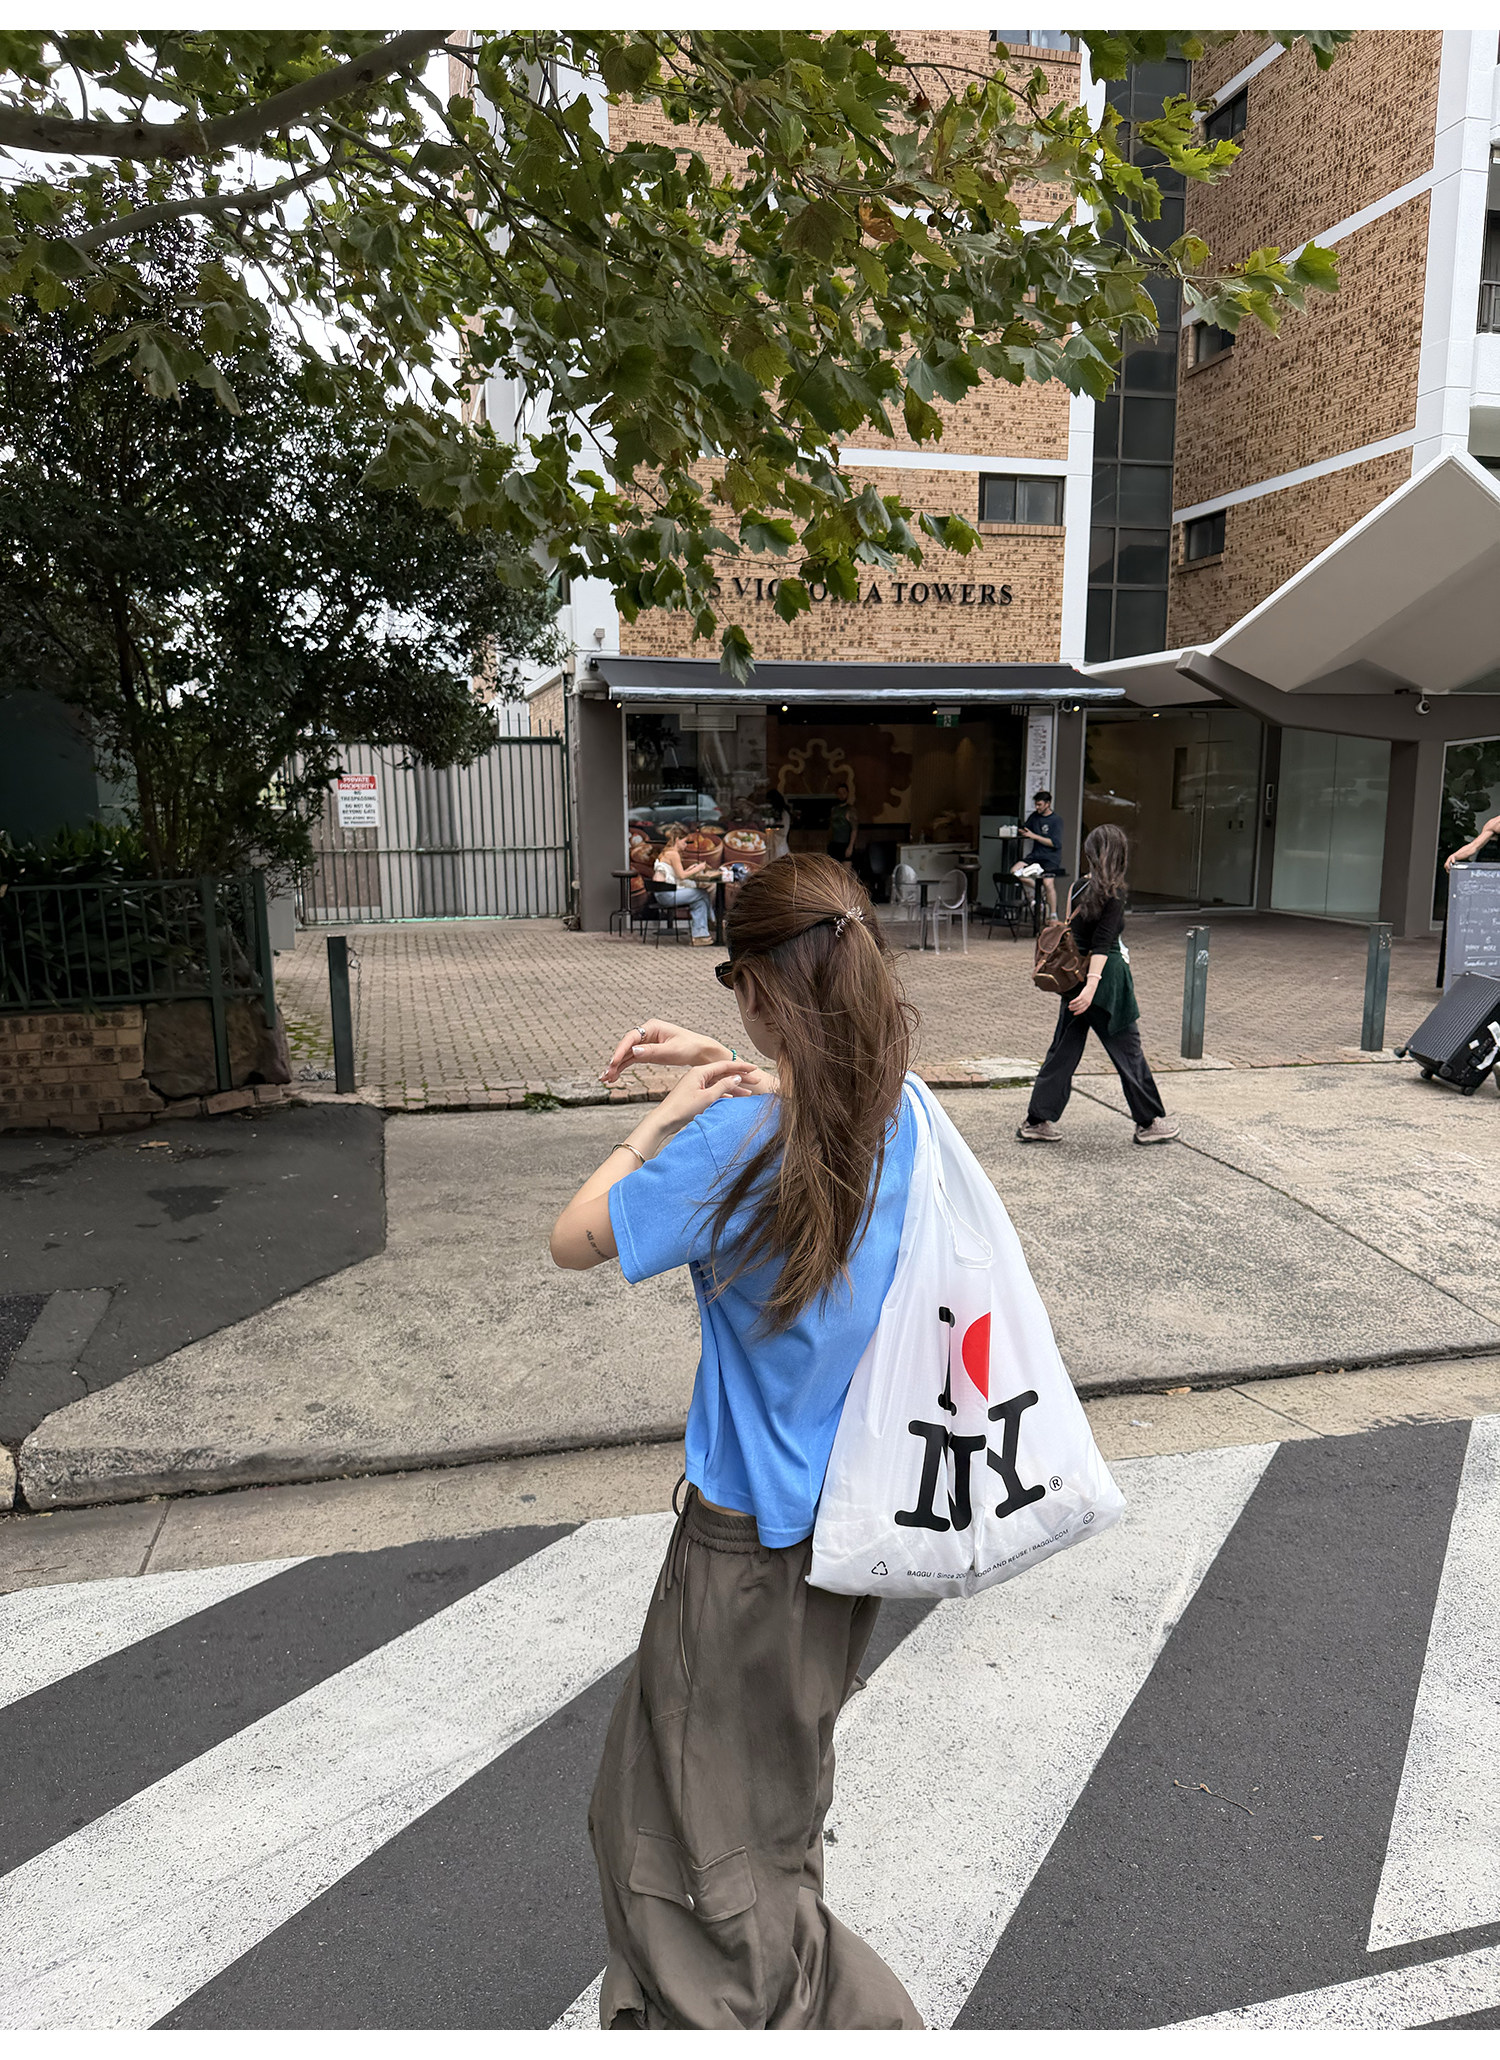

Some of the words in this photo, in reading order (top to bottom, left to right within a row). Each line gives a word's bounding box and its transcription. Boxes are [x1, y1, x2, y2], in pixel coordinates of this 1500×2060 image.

[891, 582, 1013, 605] TOWERS
[894, 1390, 1046, 1532] NY
[907, 1570, 932, 1578] BAGGU
[992, 1560, 1007, 1570] AND
[1008, 1549, 1028, 1563] REUSE
[1032, 1529, 1069, 1551] BAGGU.COM
